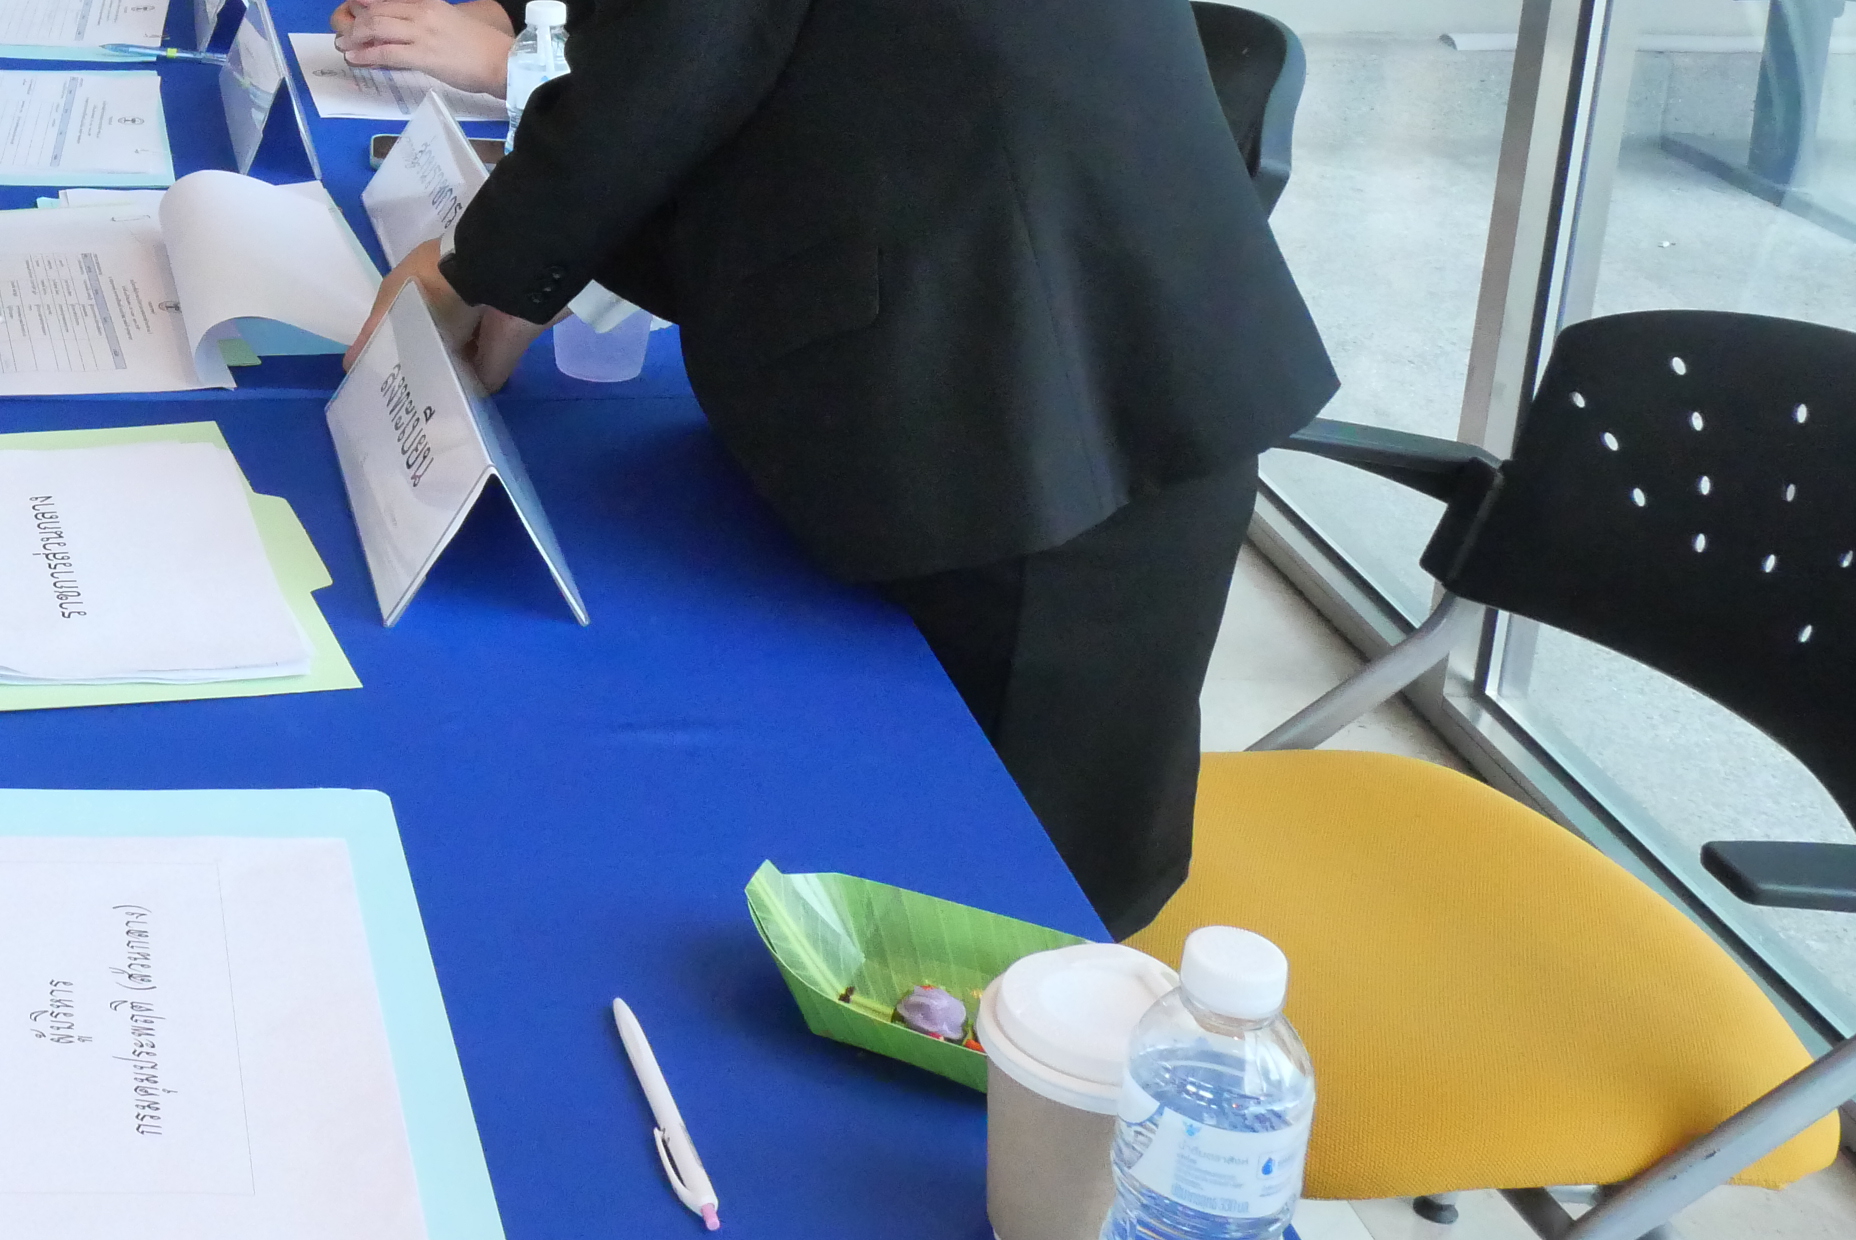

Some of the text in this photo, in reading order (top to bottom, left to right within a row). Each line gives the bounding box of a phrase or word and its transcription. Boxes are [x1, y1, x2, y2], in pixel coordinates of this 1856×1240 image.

[380, 363, 436, 488] ลงทะเบียน
[29, 495, 87, 619] ราชการส่วนกลาง
[29, 978, 93, 1044] ผู้บริหาร
[108, 904, 179, 1136] กรมคุมประพฤติ (ส่วนกลาง)
